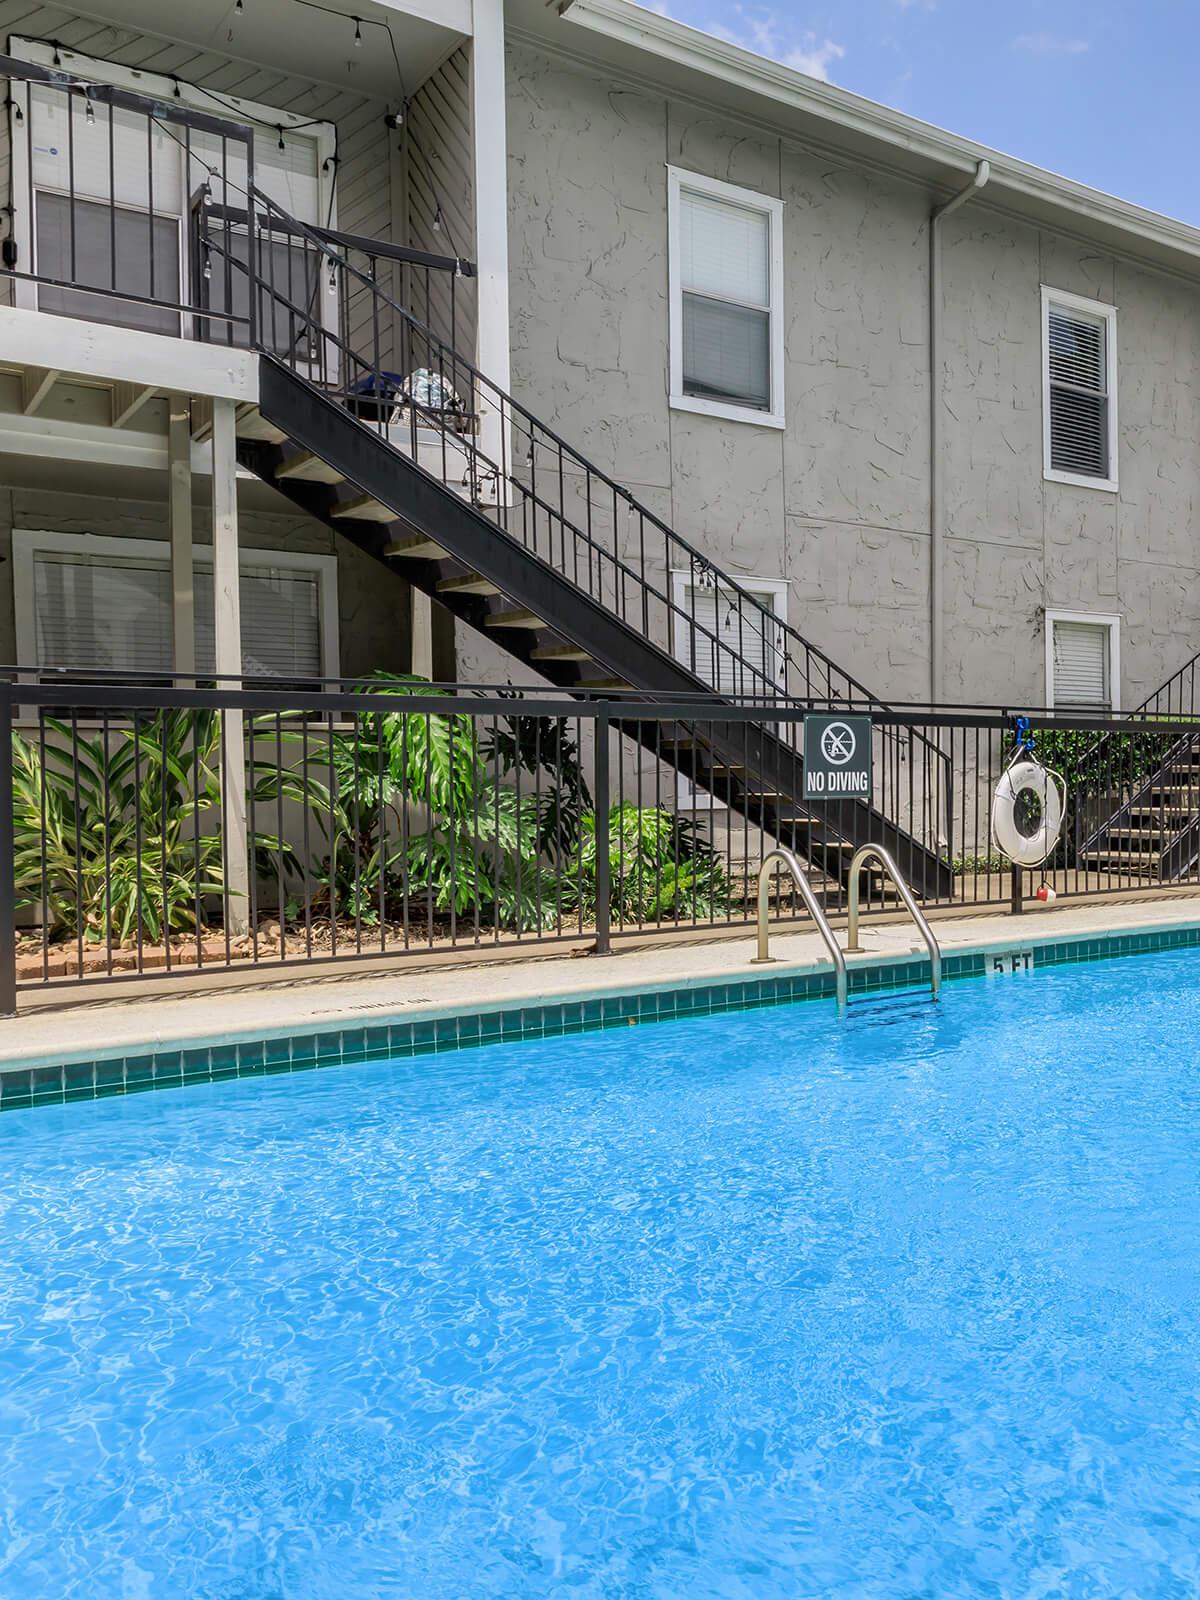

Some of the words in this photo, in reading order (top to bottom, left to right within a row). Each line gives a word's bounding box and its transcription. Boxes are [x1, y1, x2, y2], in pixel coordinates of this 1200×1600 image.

[807, 771, 825, 791] NO
[828, 771, 868, 791] DIVING
[993, 956, 1004, 973] 5
[1011, 952, 1032, 971] FT
